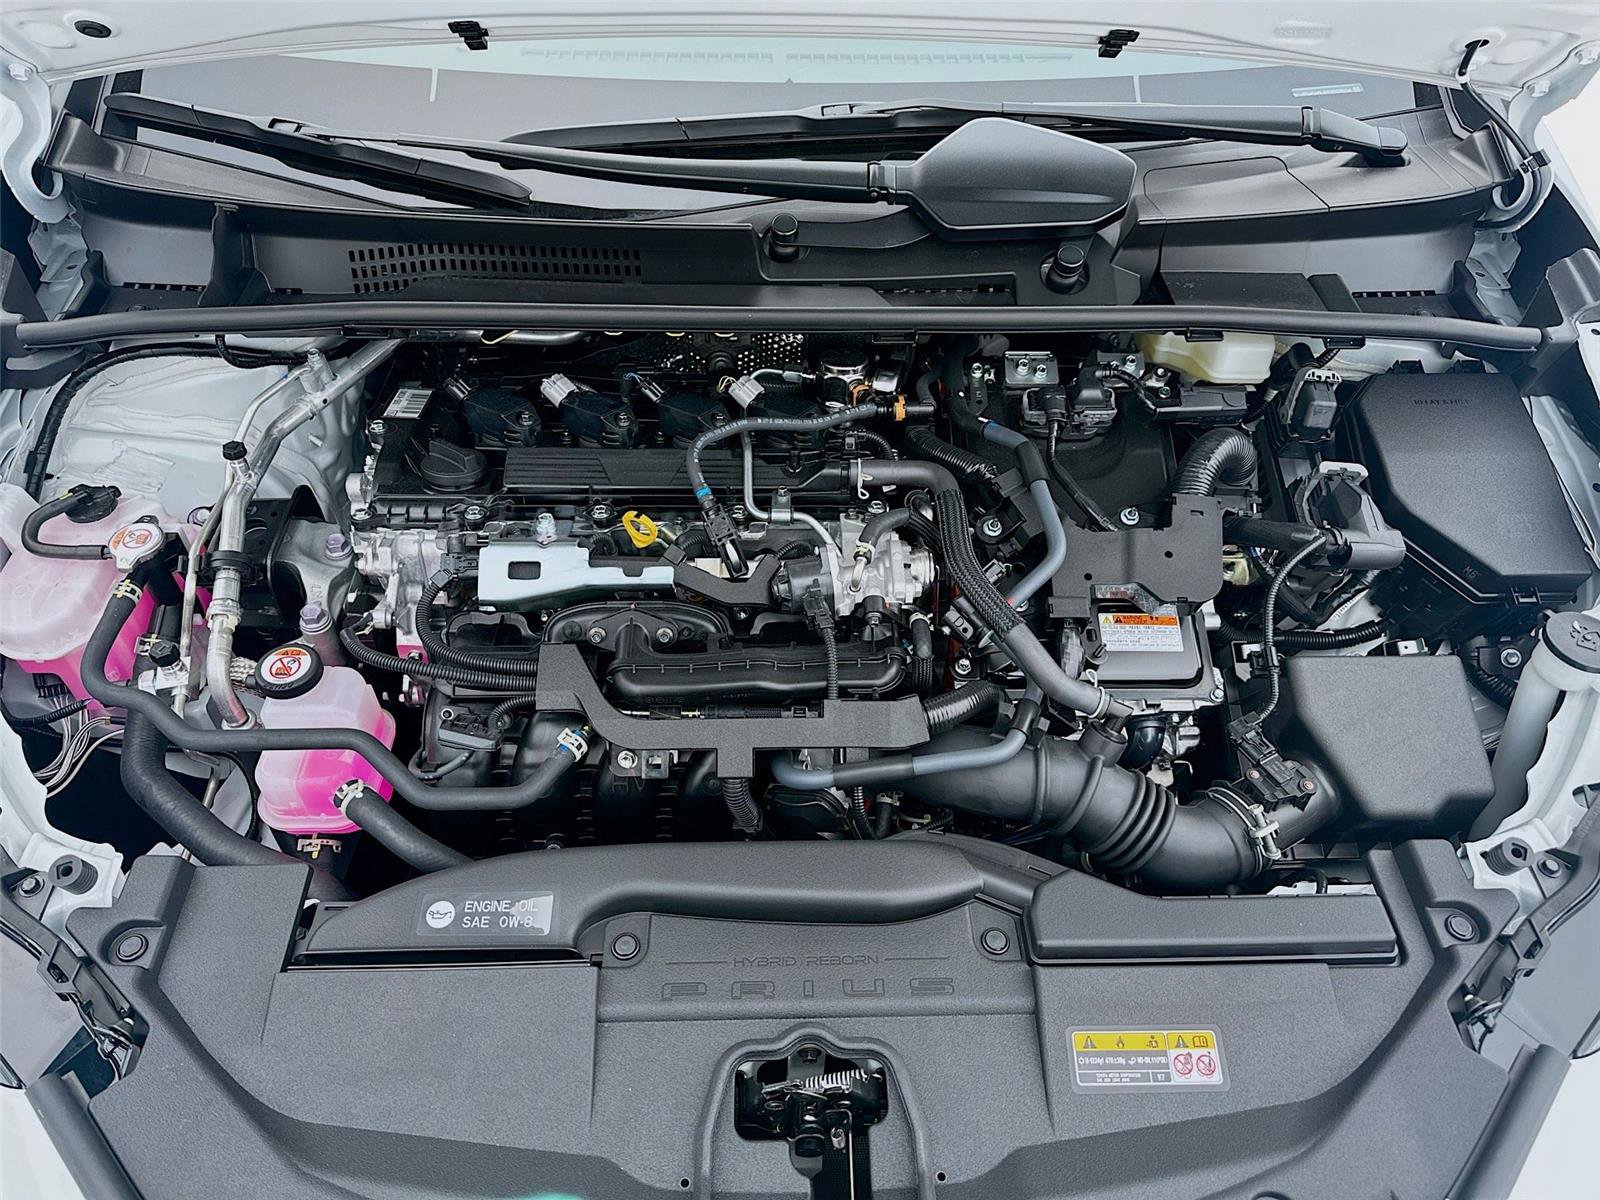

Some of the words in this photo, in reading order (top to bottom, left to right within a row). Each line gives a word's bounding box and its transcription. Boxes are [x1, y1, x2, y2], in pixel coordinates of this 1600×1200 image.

[464, 900, 511, 913] ENGINE
[519, 900, 538, 912] OIL
[461, 916, 490, 928] SAE
[733, 956, 797, 968] HYBRID
[806, 955, 879, 967] REBORN
[661, 977, 955, 1000] PRIUS
